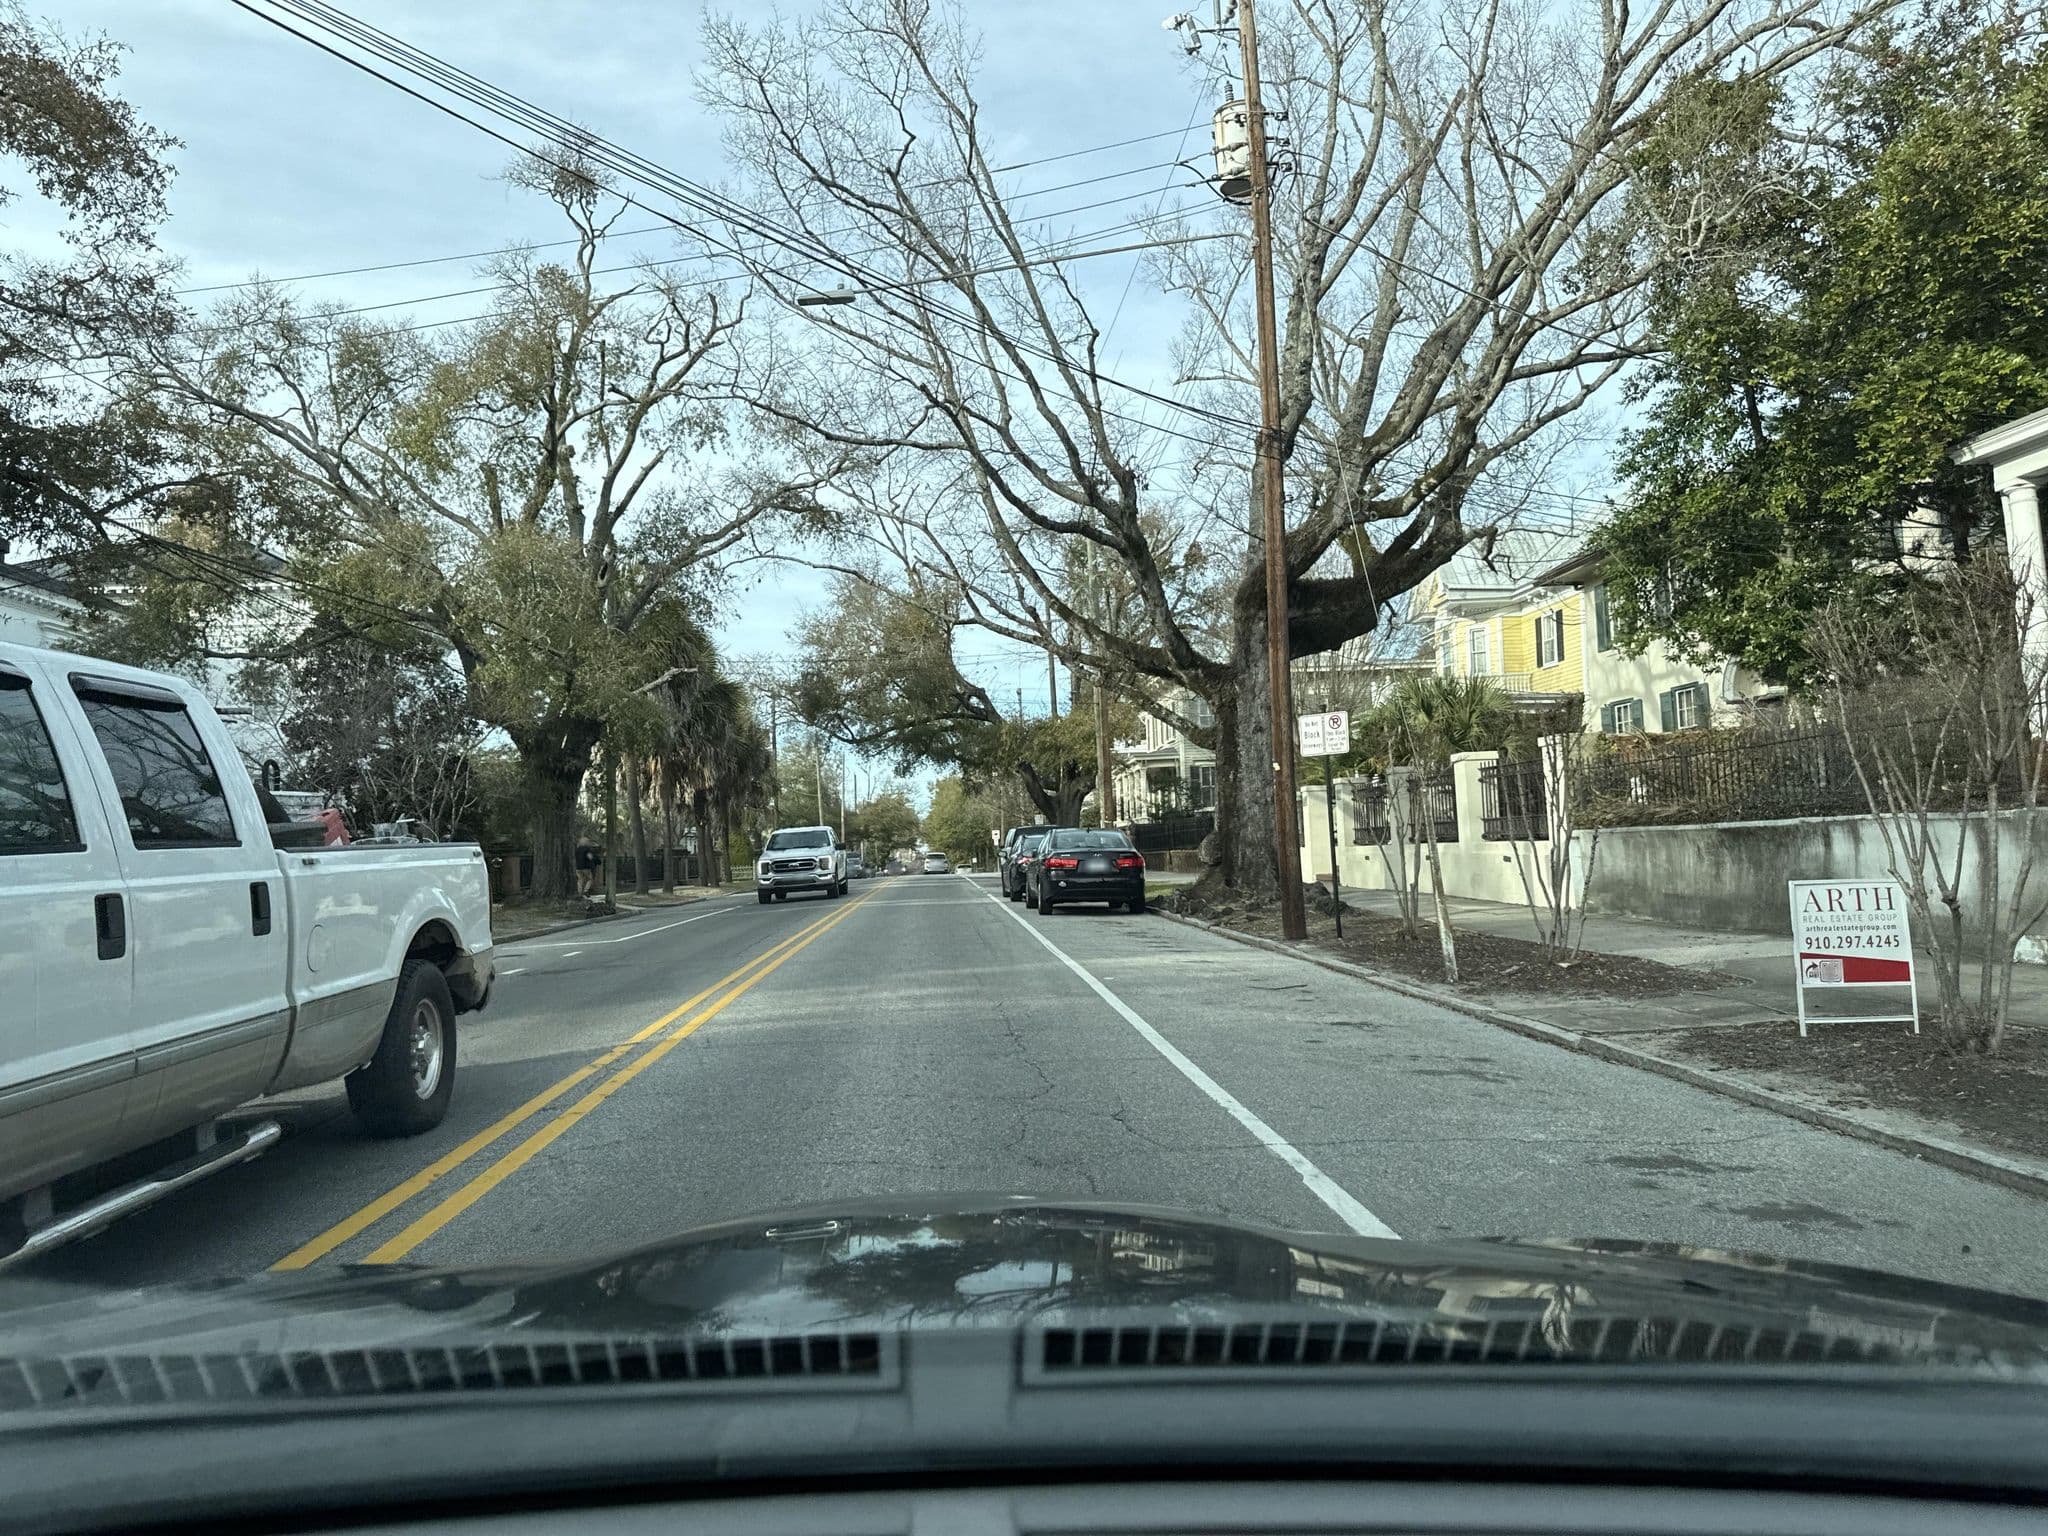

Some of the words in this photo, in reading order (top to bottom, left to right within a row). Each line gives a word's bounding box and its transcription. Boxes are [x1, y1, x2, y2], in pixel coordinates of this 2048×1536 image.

[1304, 731, 1320, 739] Block
[1803, 887, 1896, 913] ARTH
[1803, 915, 1825, 923] REAL
[1830, 914, 1863, 923] ESTATE
[1868, 913, 1897, 922] GROUP
[1806, 924, 1897, 932] arthrealestategroup.com
[1805, 935, 1900, 950] 910.297.4245
